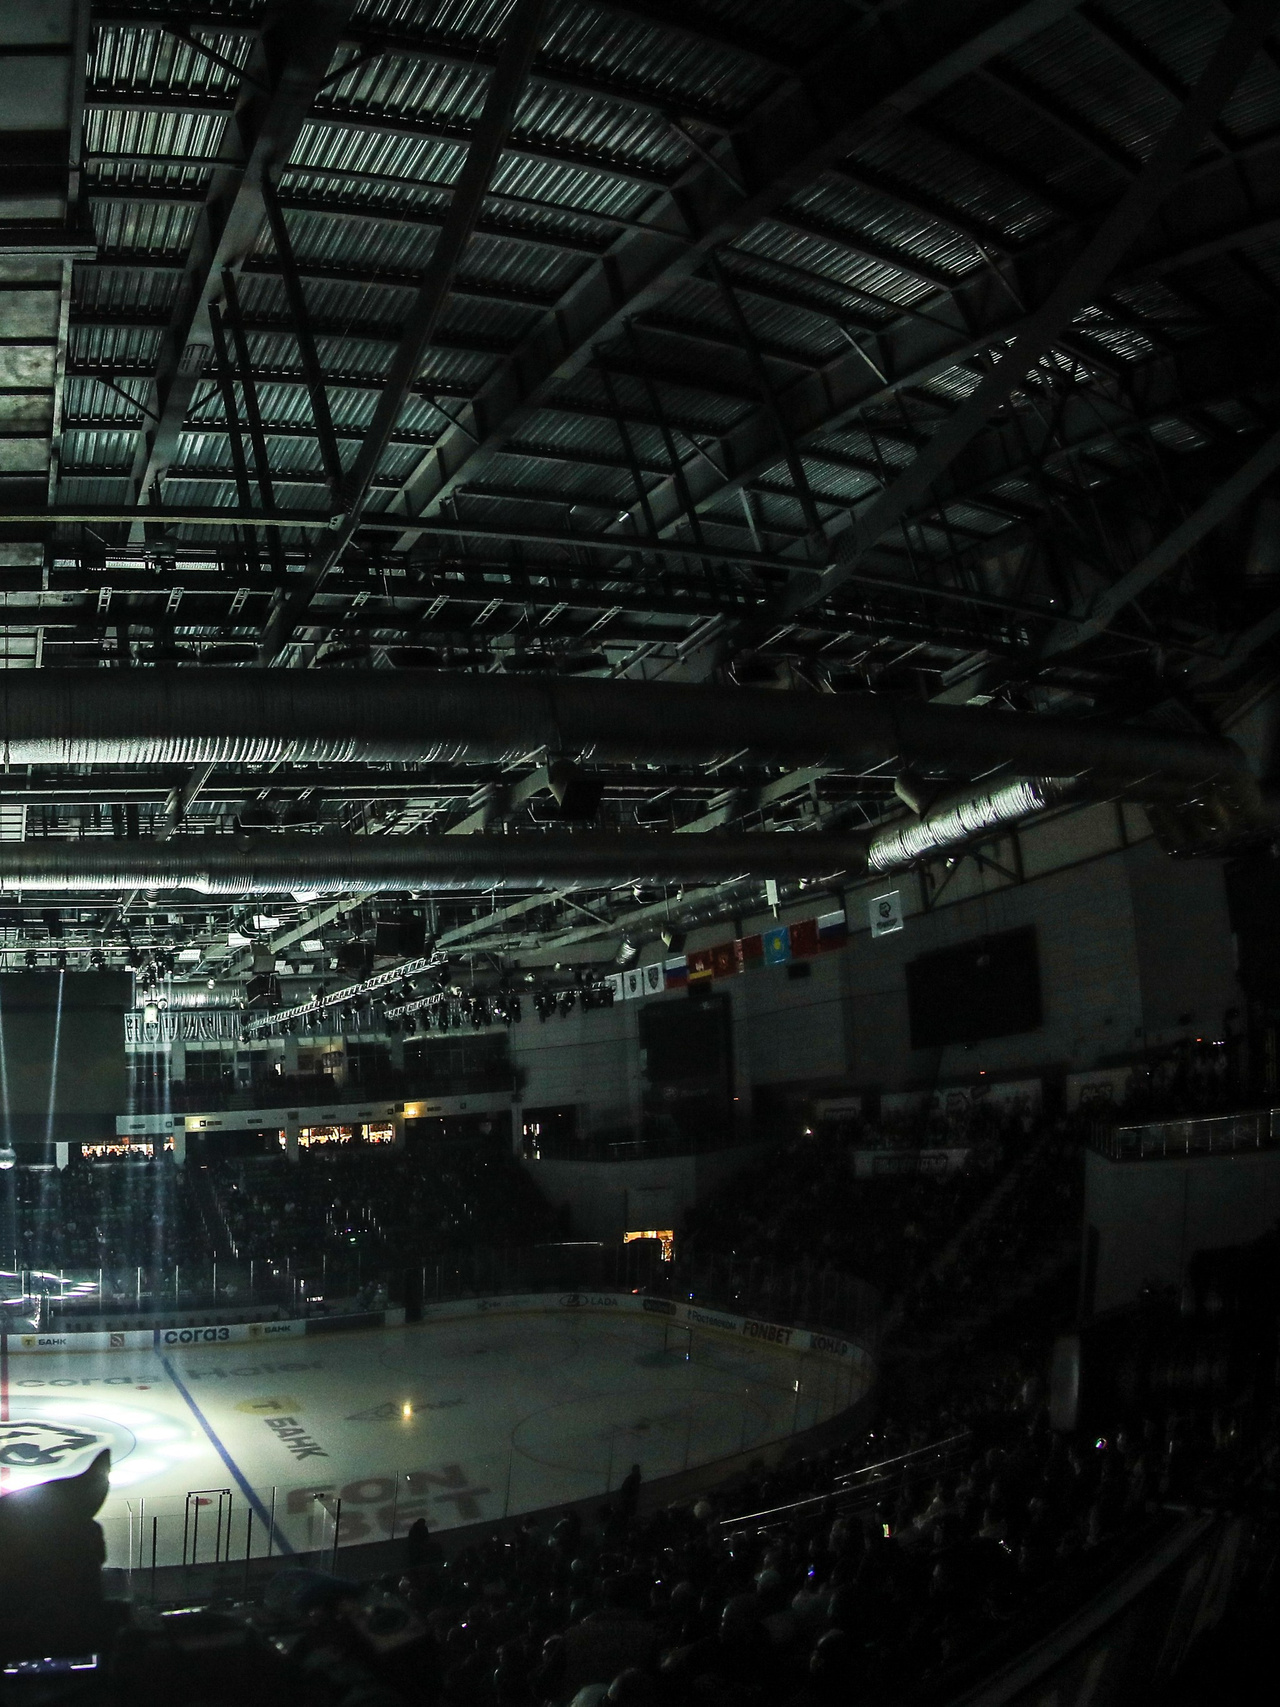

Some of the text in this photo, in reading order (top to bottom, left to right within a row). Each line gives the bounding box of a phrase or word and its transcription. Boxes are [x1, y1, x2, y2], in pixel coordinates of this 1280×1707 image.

[590, 1296, 618, 1306] LADA
[164, 1327, 230, 1344] согаз
[264, 1324, 291, 1334] БАНК
[742, 1320, 793, 1346] FONBET
[38, 1337, 67, 1346] БАНК
[264, 1416, 329, 1461] БАНК
